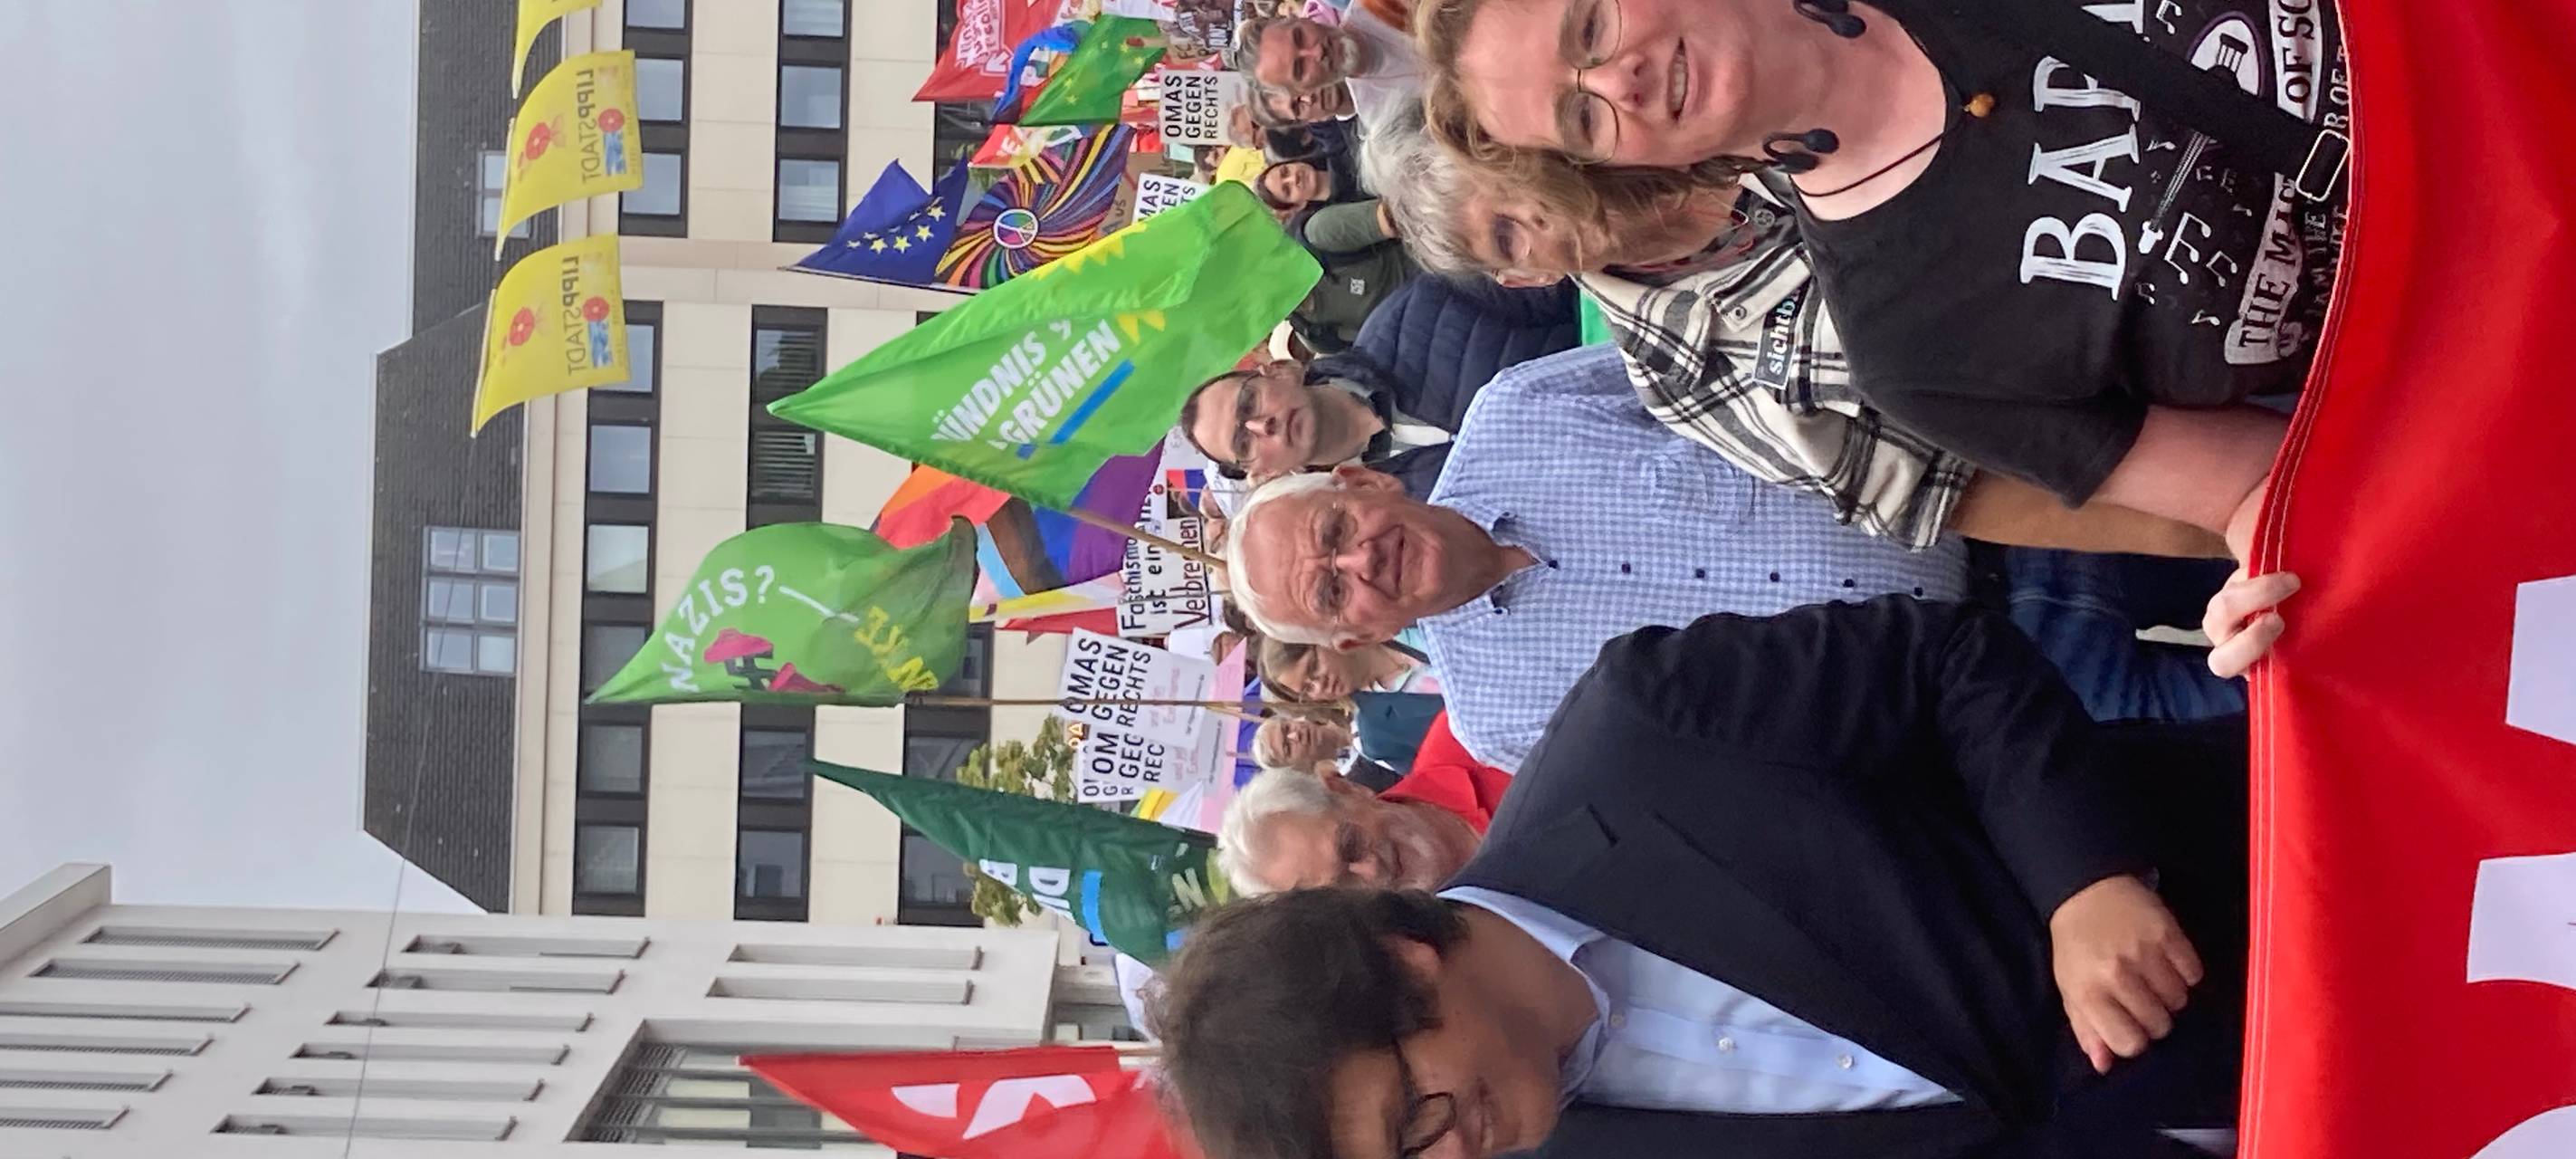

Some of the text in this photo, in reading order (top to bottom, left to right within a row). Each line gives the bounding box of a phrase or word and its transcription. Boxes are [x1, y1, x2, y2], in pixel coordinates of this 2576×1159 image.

[1164, 74, 1182, 139] OMAS
[1185, 75, 1202, 139] GEGEN
[1204, 75, 1219, 139] RECHTS
[1138, 179, 1160, 222] MAS
[2238, 273, 2291, 348] THE
[2283, 47, 2313, 103] OF
[930, 330, 1046, 441] ÜNDNIS
[661, 565, 775, 694] NAZIS?
[1064, 637, 1102, 714] OMAS
[1116, 650, 1151, 727] RECHTS
[1092, 733, 1120, 774] OM
[1143, 743, 1164, 783] REC
